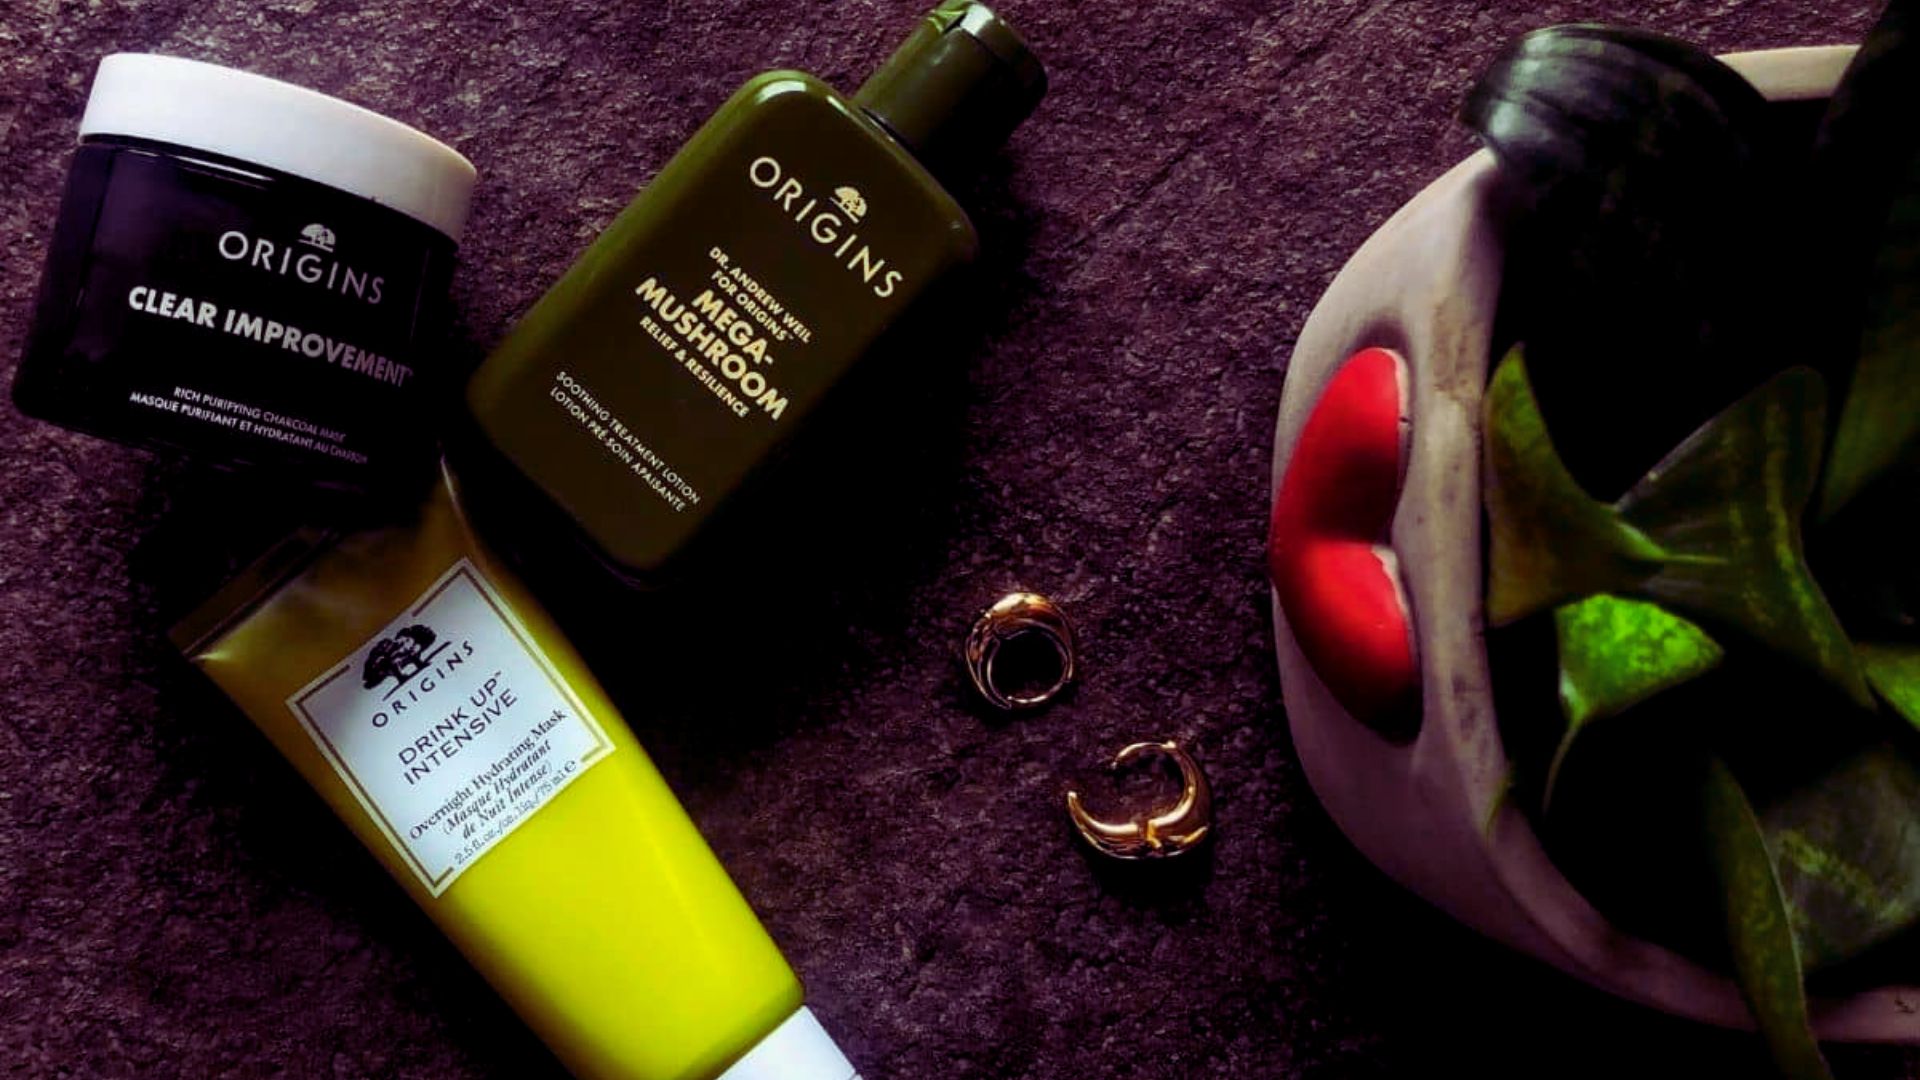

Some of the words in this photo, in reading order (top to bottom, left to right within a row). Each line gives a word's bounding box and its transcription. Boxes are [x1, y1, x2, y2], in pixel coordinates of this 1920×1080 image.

[219, 231, 384, 304] ORIGINS
[750, 156, 902, 297] ORIGINS
[128, 286, 217, 328] CLEAR
[709, 247, 730, 270] DR.
[730, 267, 784, 315] ANDREW
[782, 312, 812, 343] WEIL
[711, 270, 737, 296] FOR
[635, 277, 788, 421] MUSHROOM
[640, 316, 678, 351] RELIEF
[674, 349, 687, 363] &
[684, 357, 749, 418] RESILIENCE
[691, 289, 774, 365] MEGA-
[130, 391, 179, 412] MASQUE
[181, 404, 237, 428] PURIFIANT
[239, 420, 252, 431] ET
[254, 425, 314, 449] HYDRATANT
[314, 441, 329, 453] AU
[173, 386, 200, 402] RICH
[203, 394, 261, 419] PURIFYING
[556, 371, 610, 421] SOOTHING
[609, 418, 665, 470] TREATMENT
[662, 468, 700, 505] LOTION
[550, 386, 589, 423] LOTION
[631, 462, 686, 512] APAISANTE
[372, 640, 474, 728] ORIGINS
[398, 707, 469, 766] DRINK
[403, 688, 518, 785] INTENSIVE
[410, 786, 473, 840] Overnight
[472, 737, 536, 790] Hydrating
[530, 708, 567, 741] Mask
[494, 739, 551, 795] Hydratant
[462, 825, 477, 840] de
[477, 797, 507, 826] Nuit
